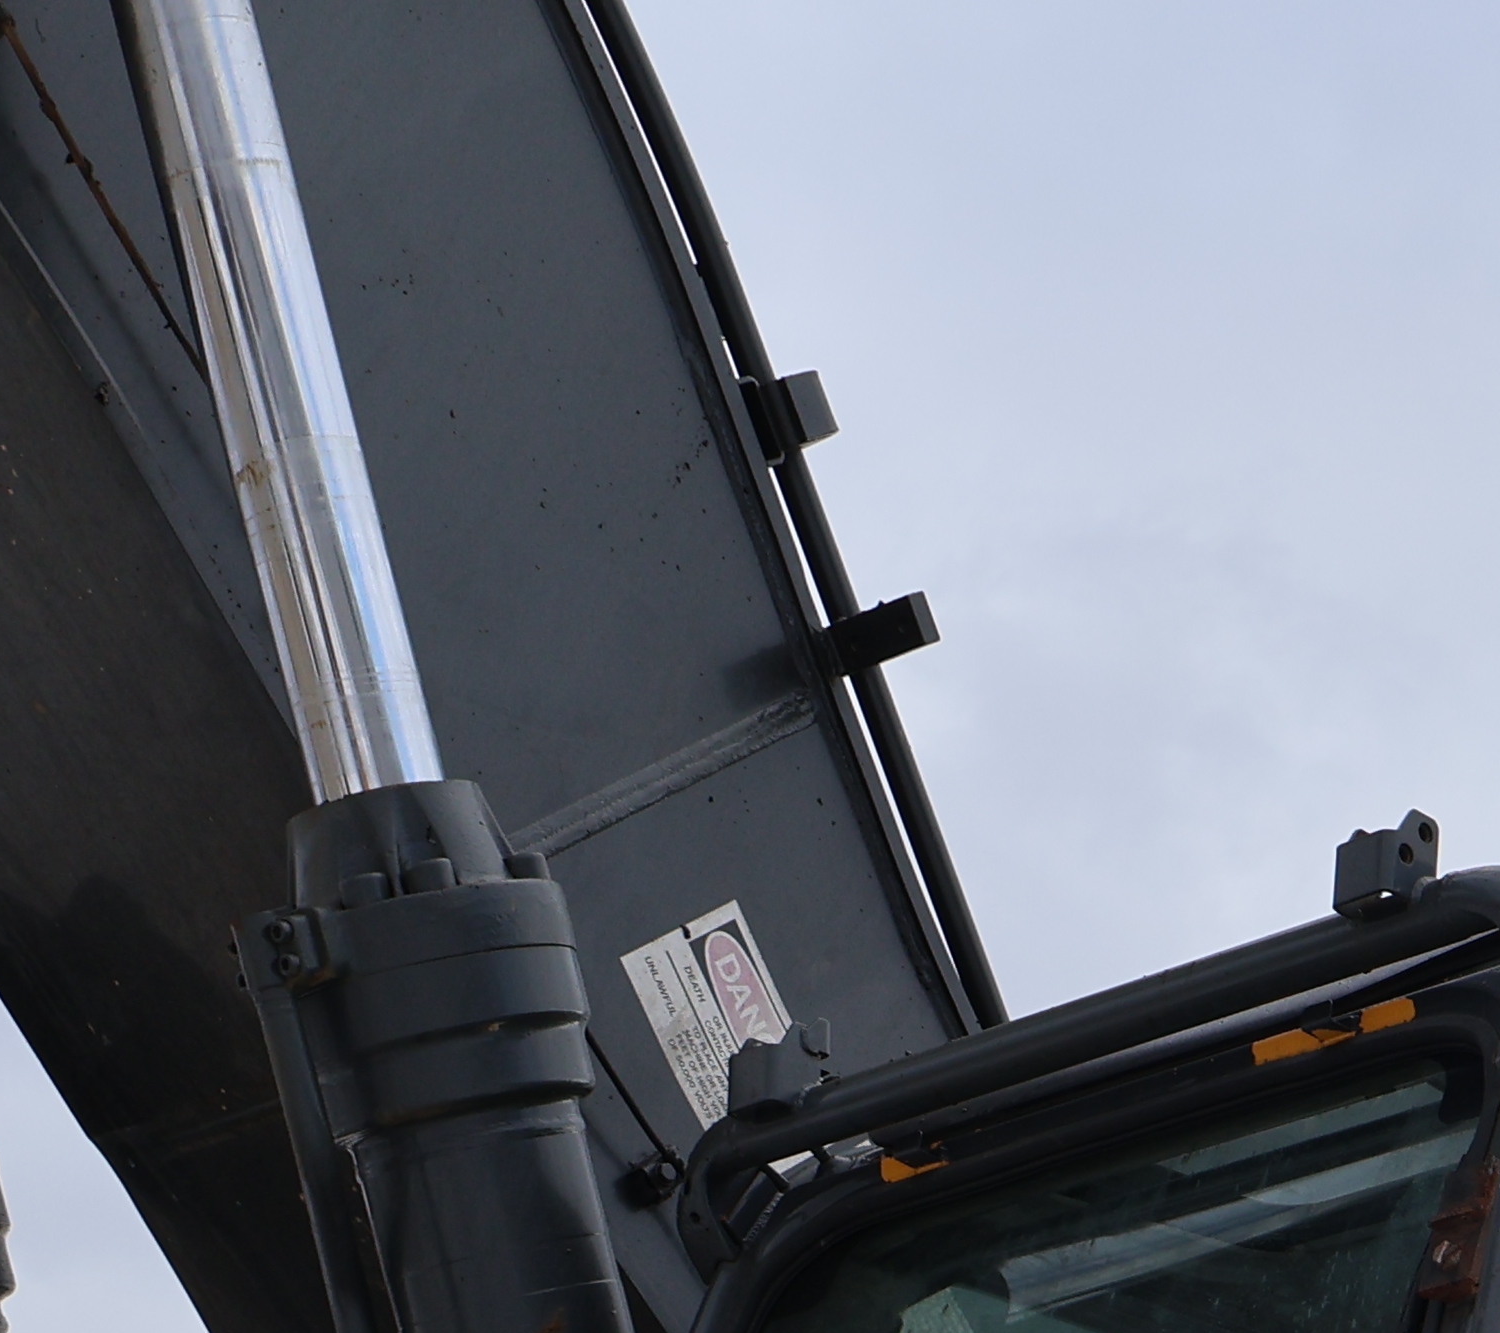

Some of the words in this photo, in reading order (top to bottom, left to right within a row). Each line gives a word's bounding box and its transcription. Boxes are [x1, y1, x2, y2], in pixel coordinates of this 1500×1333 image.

[645, 956, 677, 1017] UNLAWFUL
[684, 966, 706, 1002] DEATH
[713, 1016, 724, 1029] OR
[668, 1038, 679, 1051] OF
[695, 1091, 712, 1120] VOLTS
[676, 1034, 691, 1057] FEET
[689, 1062, 700, 1075] OF
[697, 1076, 712, 1098] HIGH
[683, 1029, 707, 1071] MACHINE
[707, 1075, 718, 1088] OR
[715, 1090, 728, 1111] LOA
[692, 1026, 701, 1038] TO
[700, 1042, 718, 1071] PLACE
[716, 1075, 728, 1092] ANY
